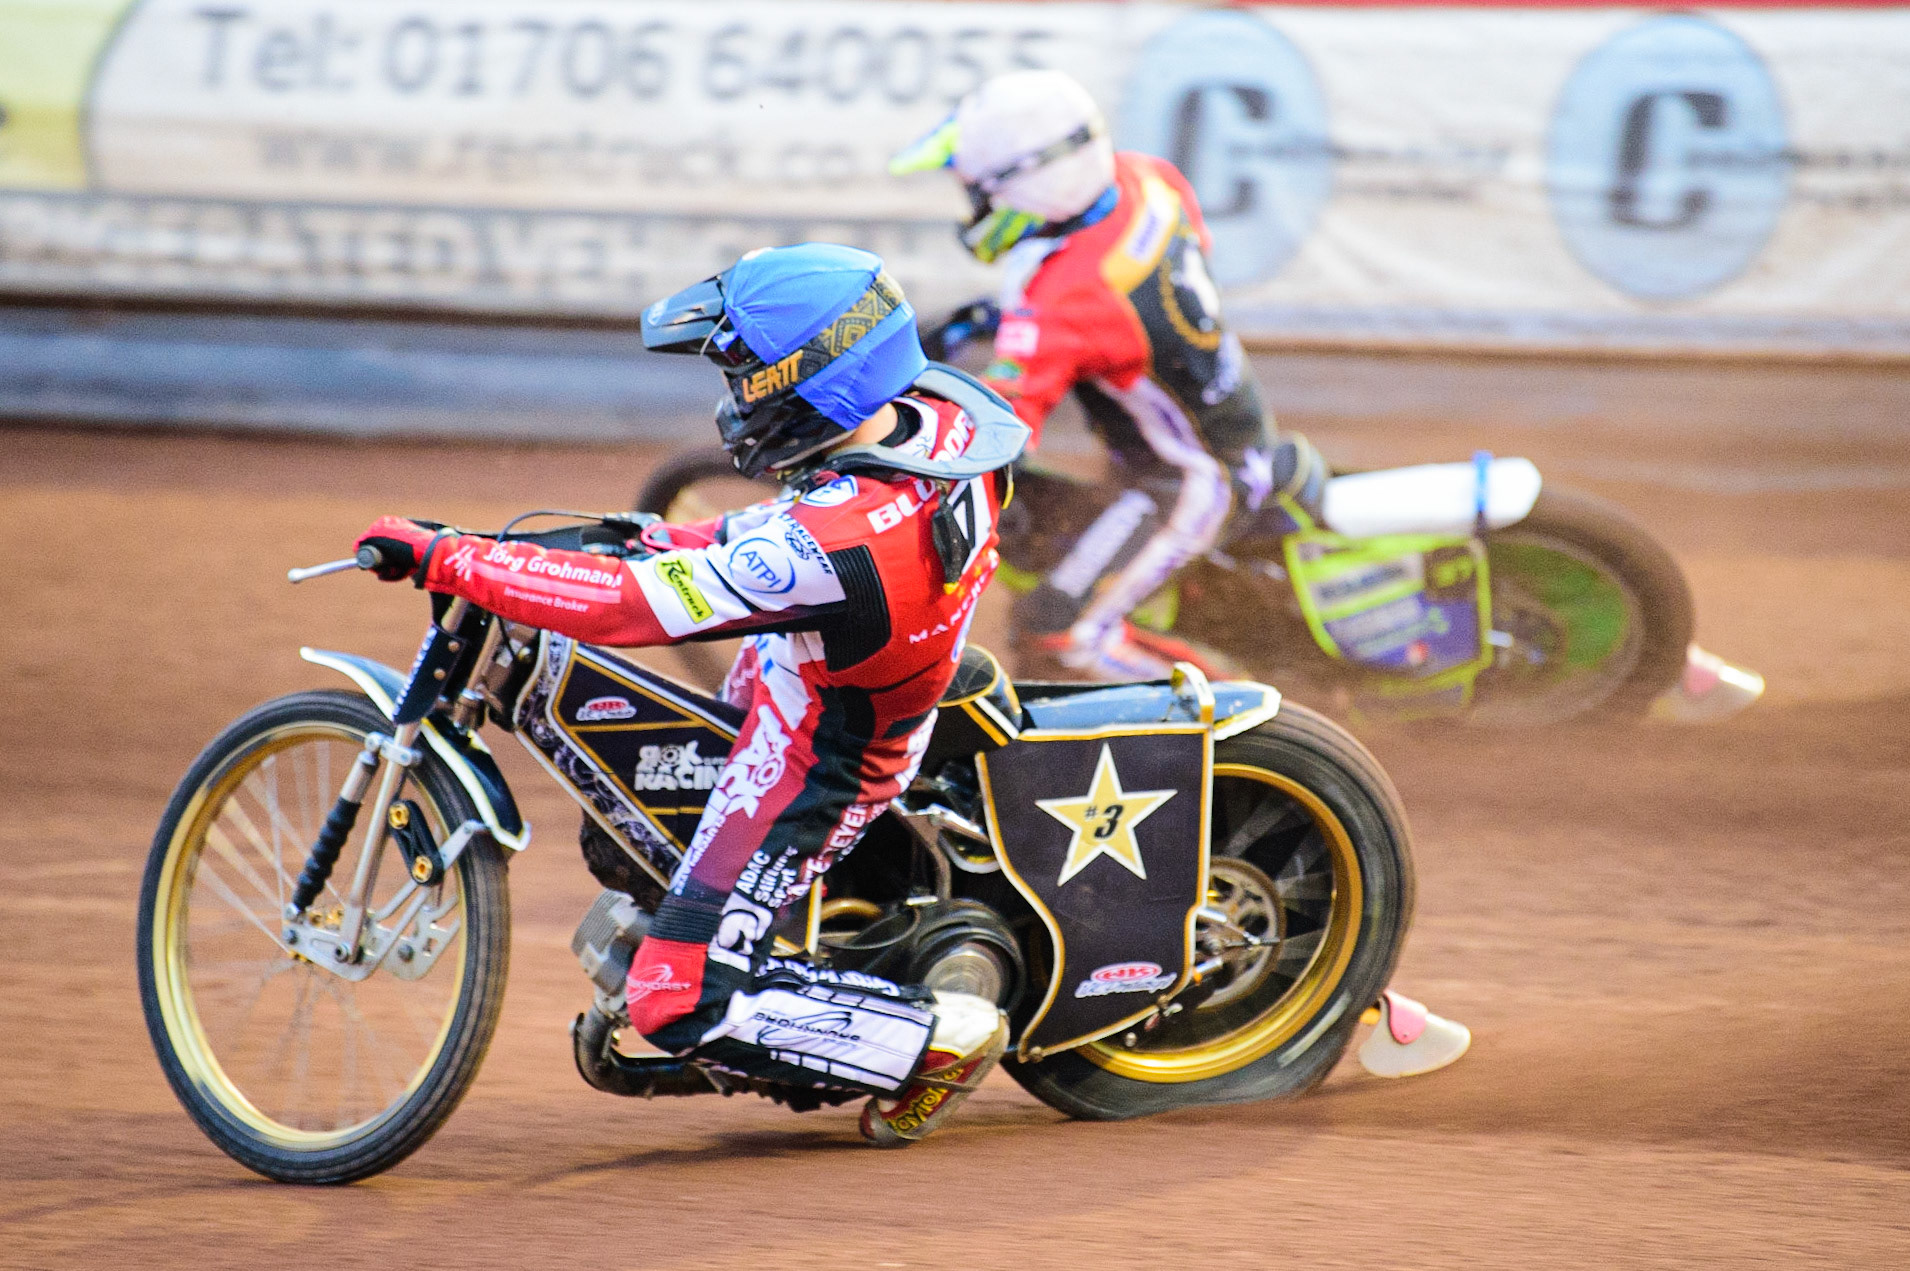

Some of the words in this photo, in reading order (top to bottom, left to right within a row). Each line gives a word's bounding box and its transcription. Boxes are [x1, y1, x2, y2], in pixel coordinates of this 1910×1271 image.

[195, 8, 358, 93] Tel:
[381, 18, 672, 99] 01706
[483, 546, 526, 572] Jörg
[739, 550, 782, 588] ATPI
[553, 598, 589, 613] Broker
[660, 559, 704, 618] Rentruck
[735, 850, 771, 895] ADAC
